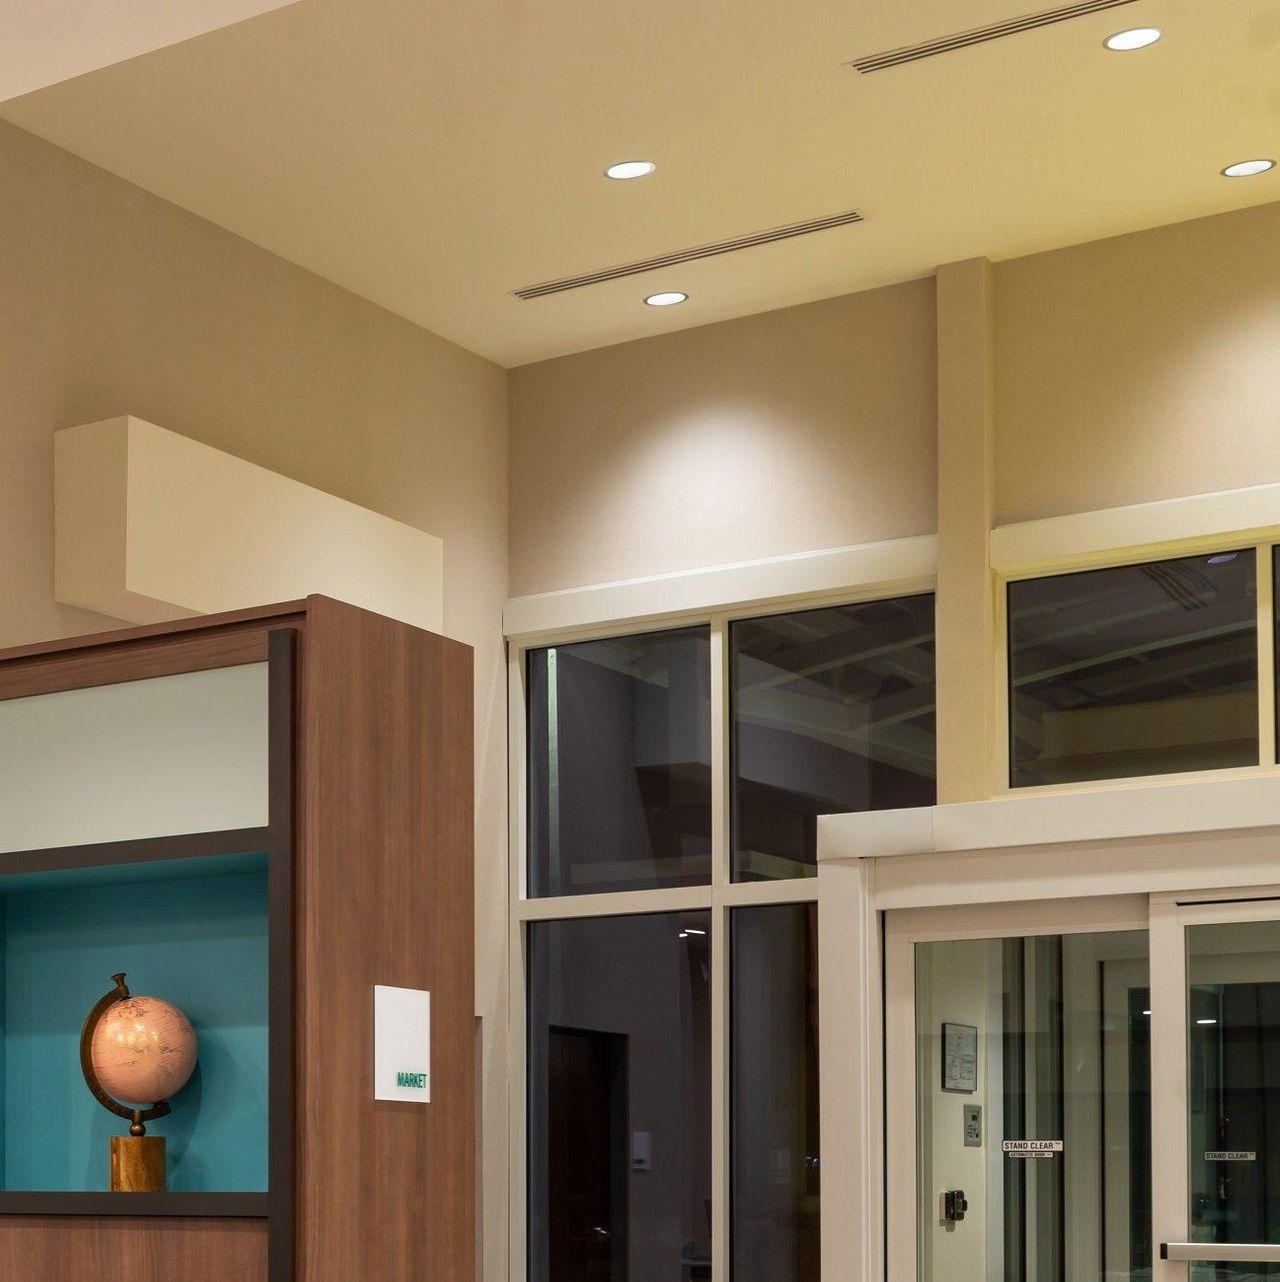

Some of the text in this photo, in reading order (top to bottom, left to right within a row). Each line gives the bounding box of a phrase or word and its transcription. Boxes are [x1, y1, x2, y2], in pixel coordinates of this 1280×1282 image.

[397, 1071, 427, 1088] MARKET
[1004, 1142, 1054, 1150] STAND CLEAR
